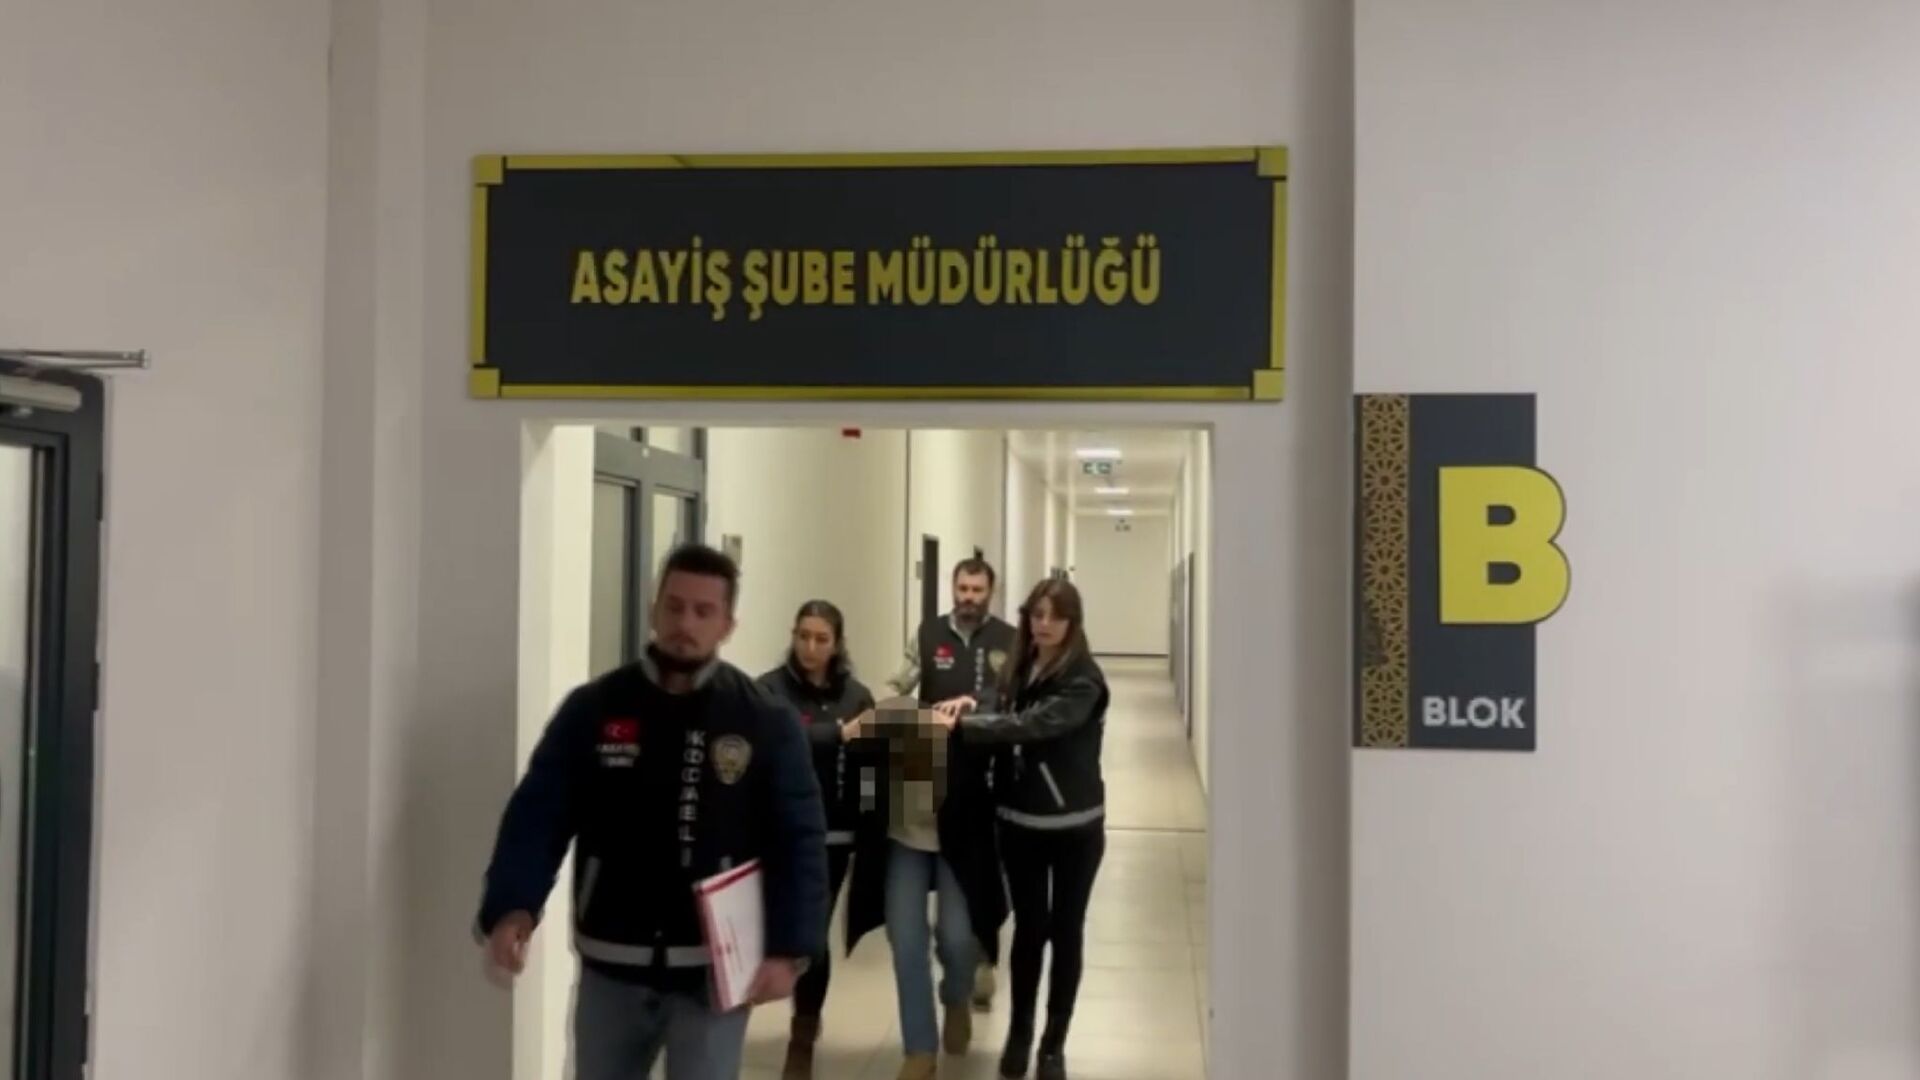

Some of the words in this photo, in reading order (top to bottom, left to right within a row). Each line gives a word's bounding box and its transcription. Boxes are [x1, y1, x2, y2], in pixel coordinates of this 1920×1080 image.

[571, 236, 731, 320] ASAYİŞ
[743, 250, 855, 320] ŞUBE
[867, 235, 1161, 305] MÜDÜRLÜĞÜ
[1438, 466, 1571, 625] B
[1422, 696, 1526, 728] BLOK
